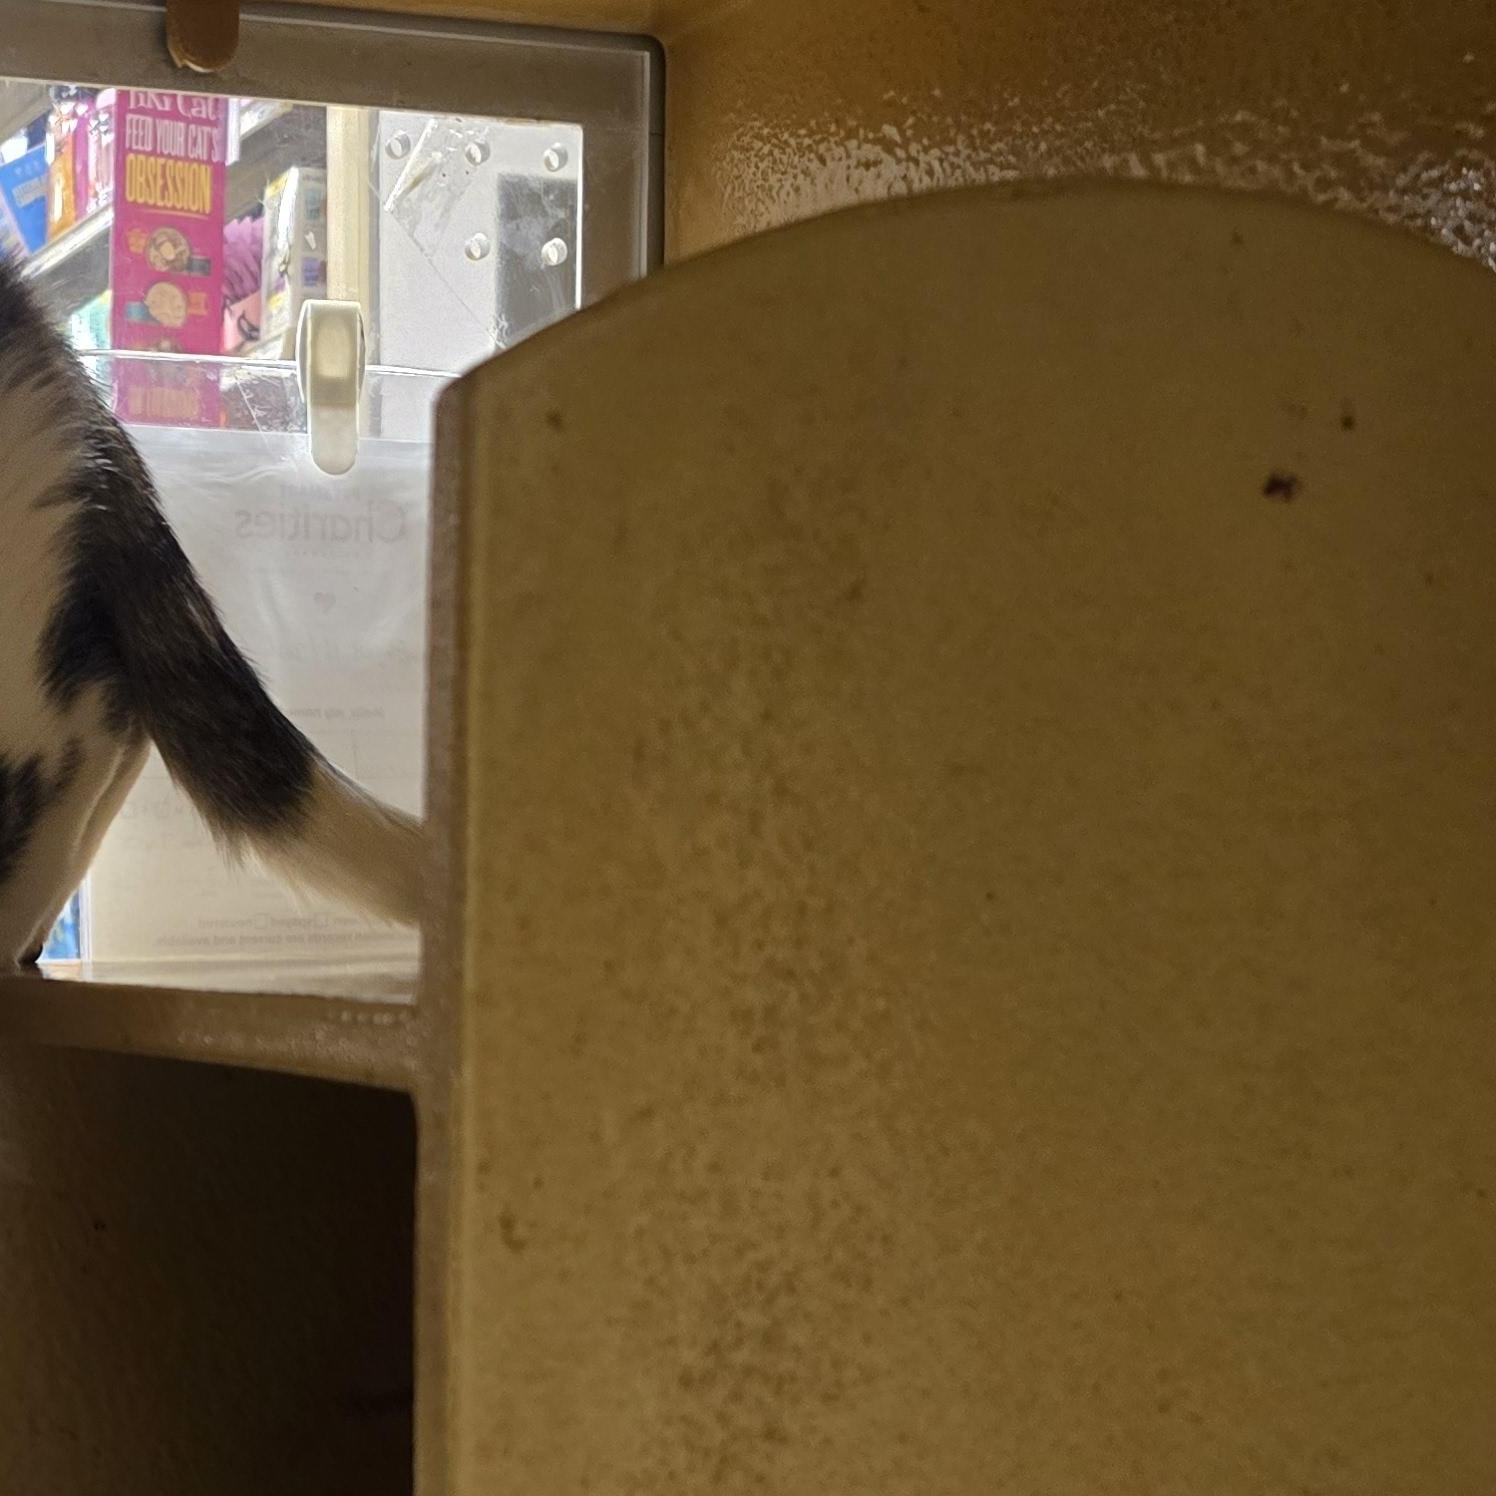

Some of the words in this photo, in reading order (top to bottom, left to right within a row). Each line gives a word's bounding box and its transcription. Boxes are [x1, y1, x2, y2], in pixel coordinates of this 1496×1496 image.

[125, 113, 153, 152] FEED
[155, 118, 186, 157] YOUR
[125, 153, 212, 213] OBSESSION
